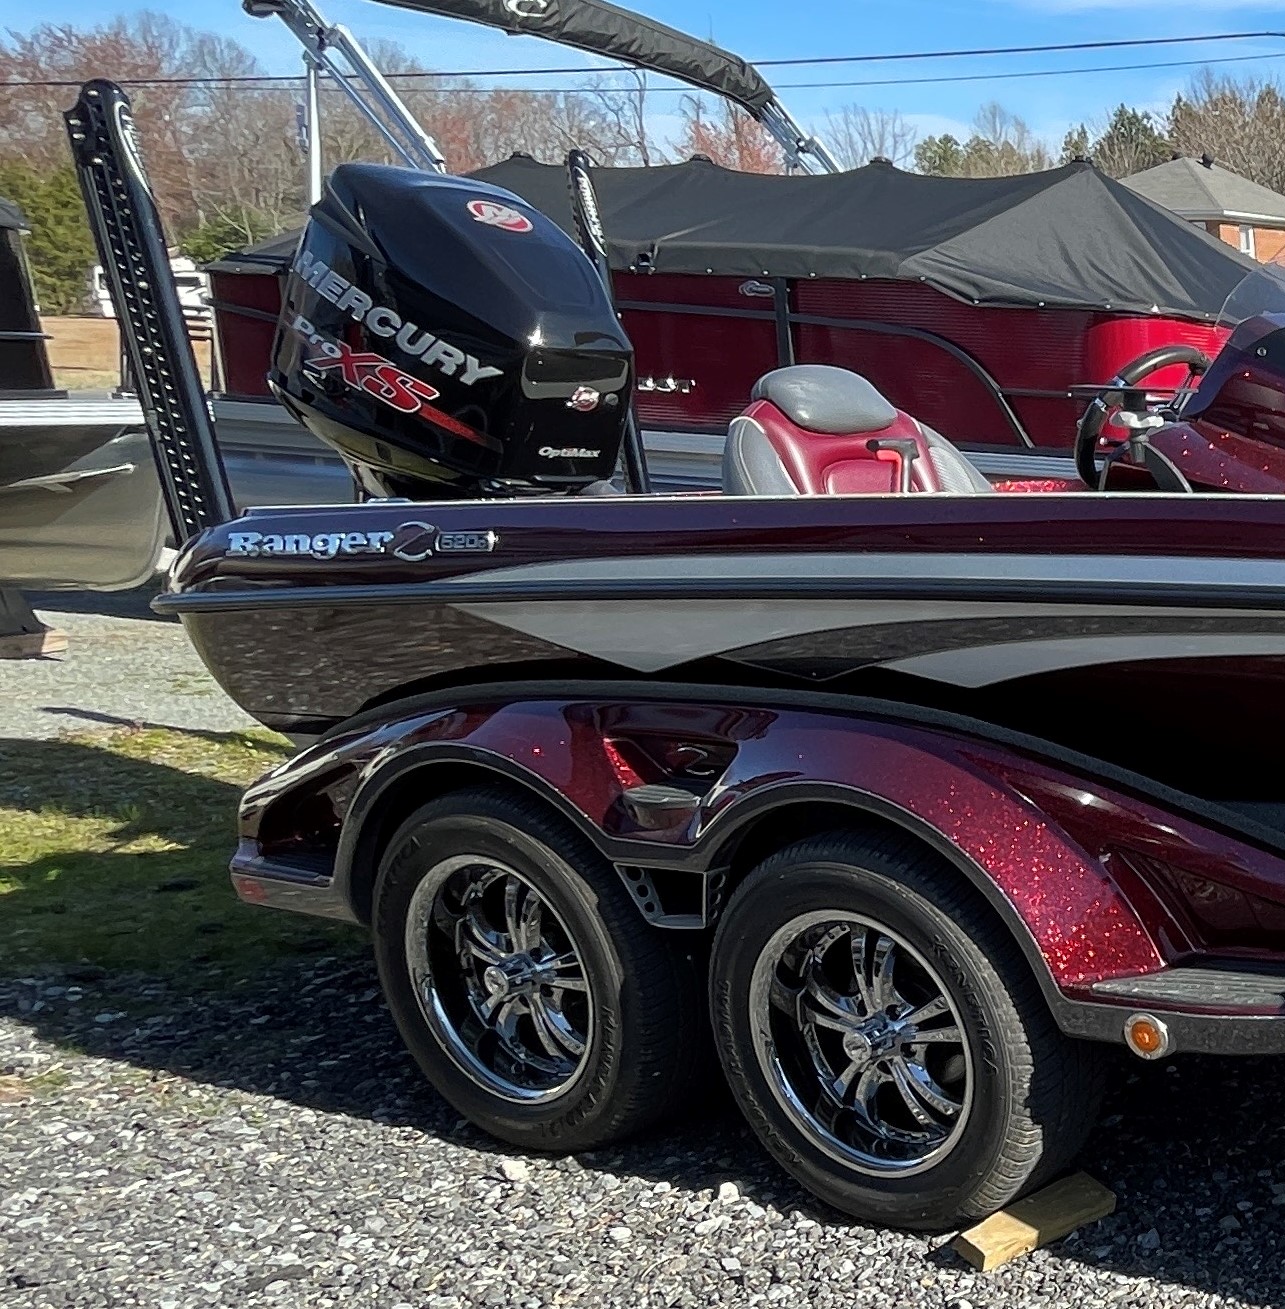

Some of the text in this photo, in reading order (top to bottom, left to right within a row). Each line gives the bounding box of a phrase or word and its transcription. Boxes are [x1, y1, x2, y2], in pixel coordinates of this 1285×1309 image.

[293, 315, 440, 413] Pro XS
[295, 250, 504, 386] MERCURY
[225, 530, 394, 560] Ranger
